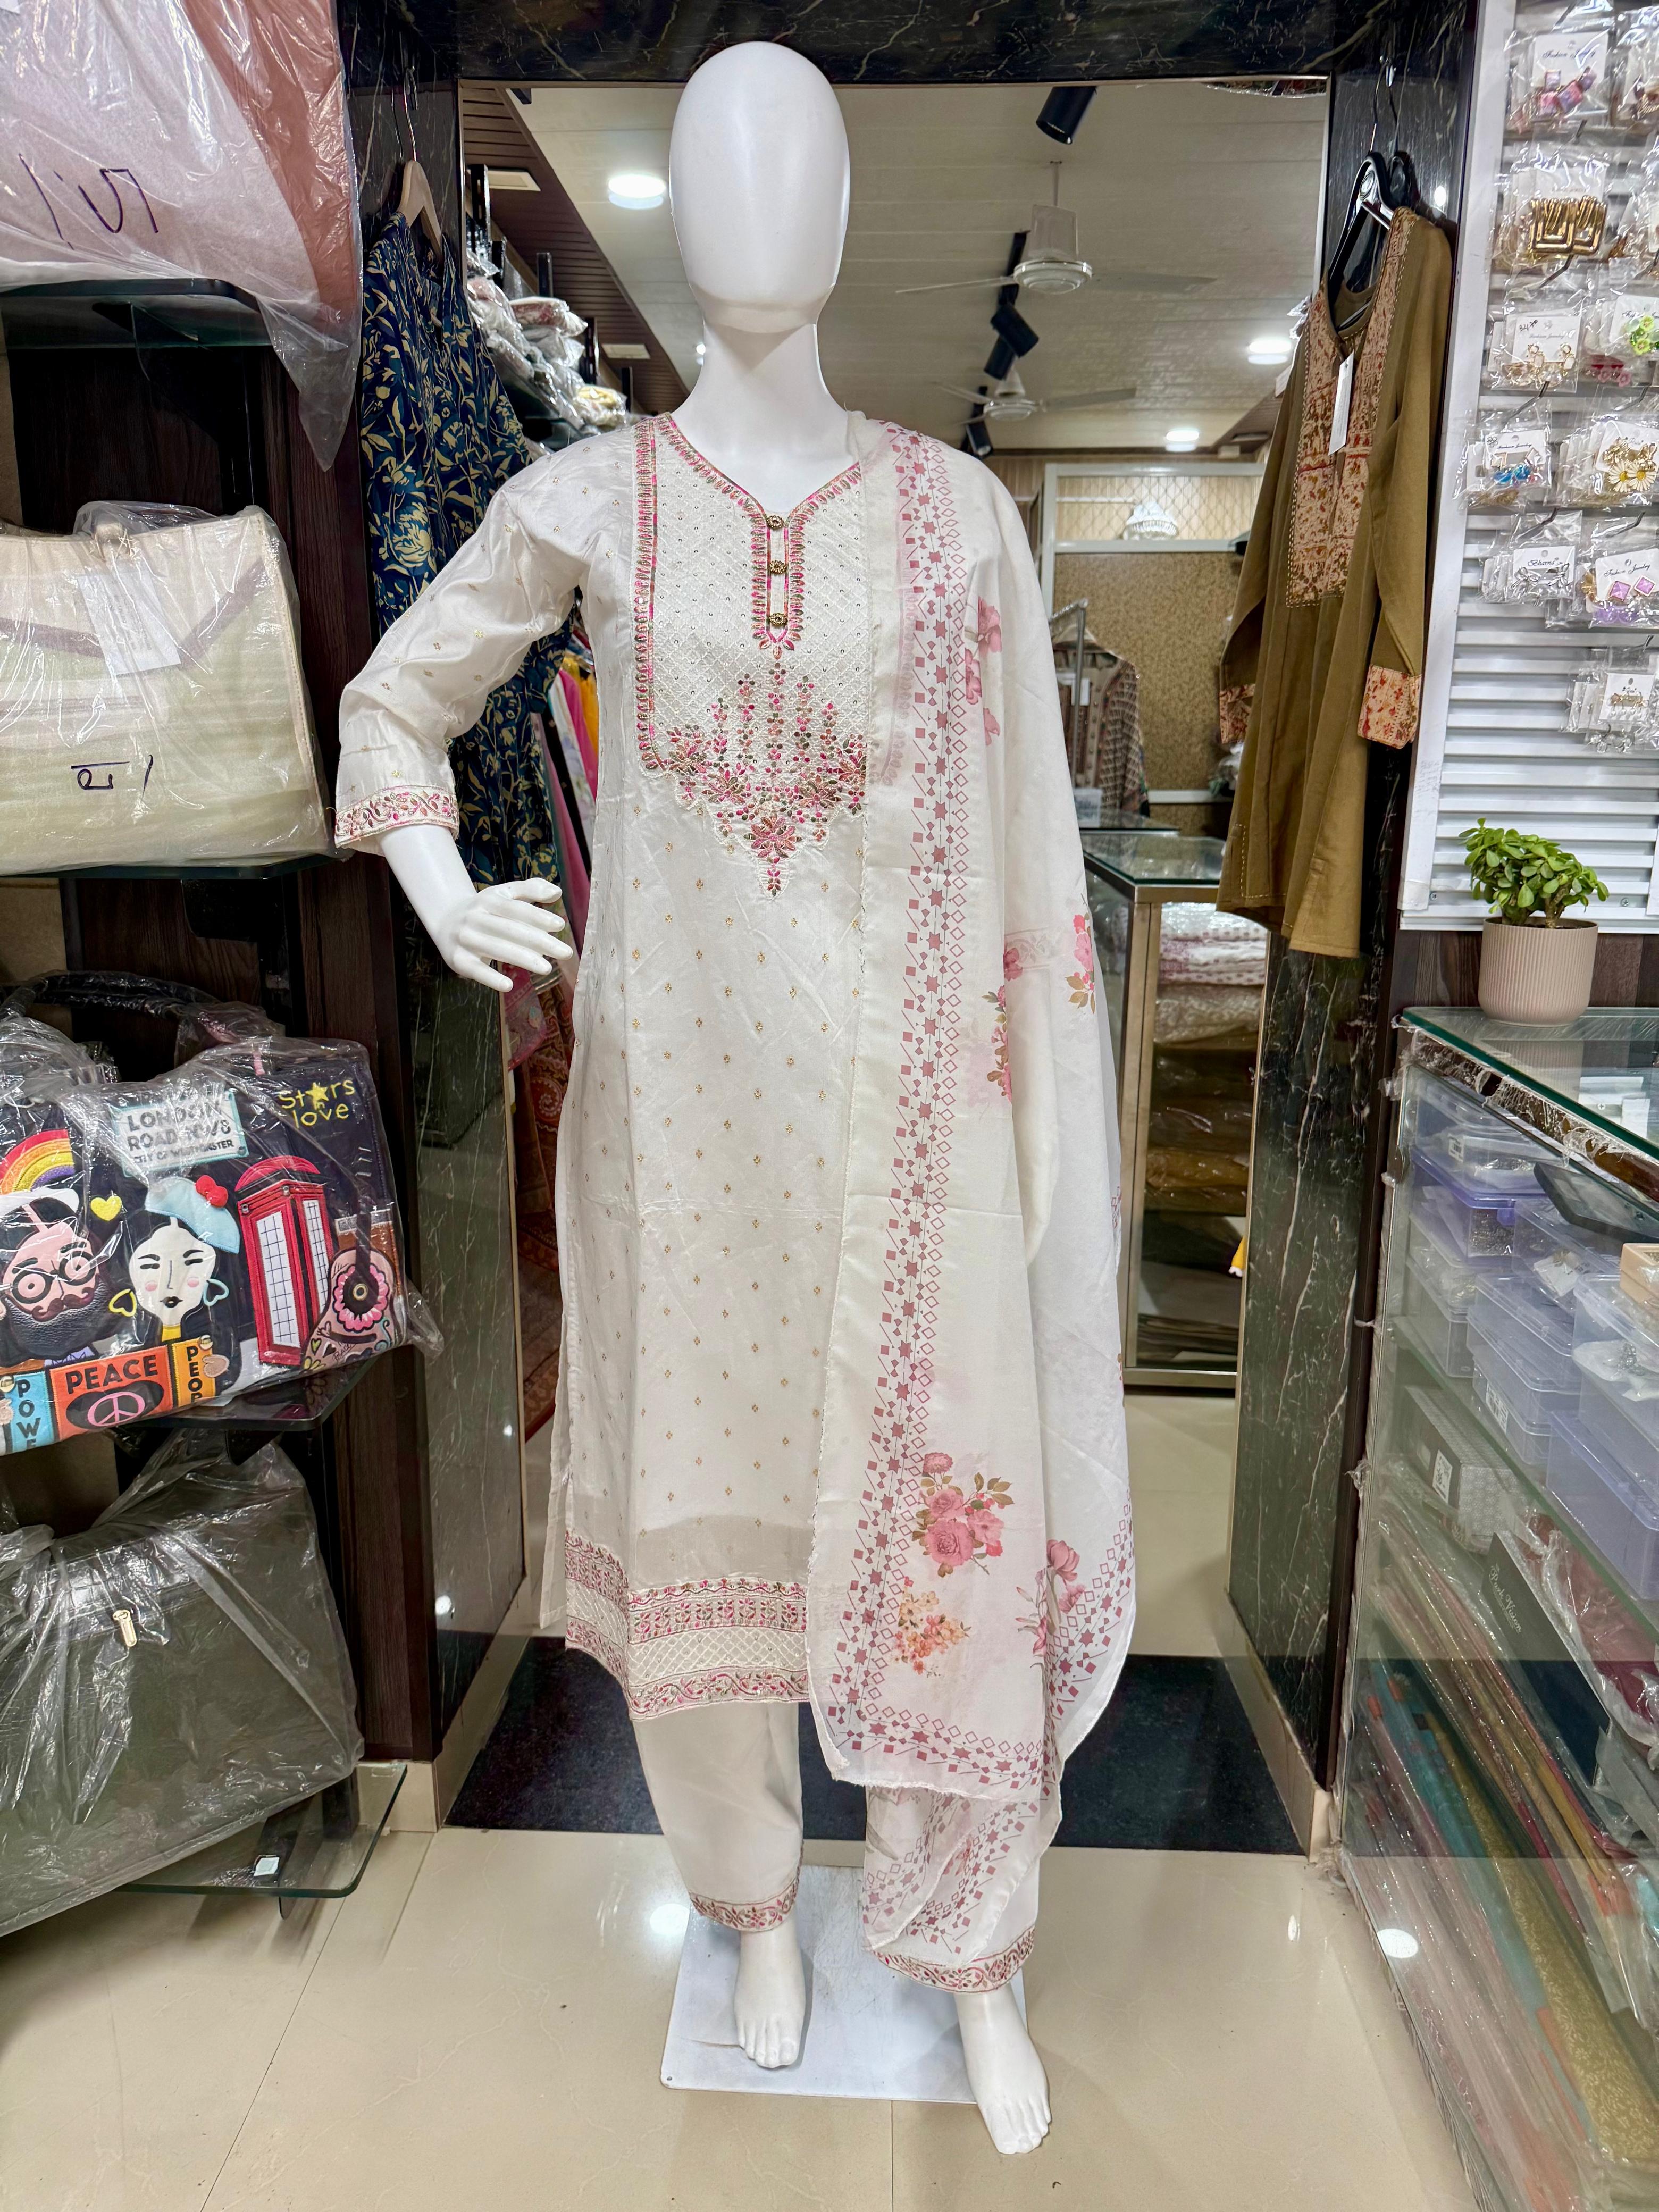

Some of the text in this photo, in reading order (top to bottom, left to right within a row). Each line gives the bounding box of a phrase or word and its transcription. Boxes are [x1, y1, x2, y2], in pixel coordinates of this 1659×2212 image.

[127, 1101, 221, 1132] LOND
[293, 1103, 349, 1129] love
[127, 1128, 178, 1152] ROAD
[170, 1139, 234, 1157] WESTINSTER
[65, 1355, 159, 1394] PEACE
